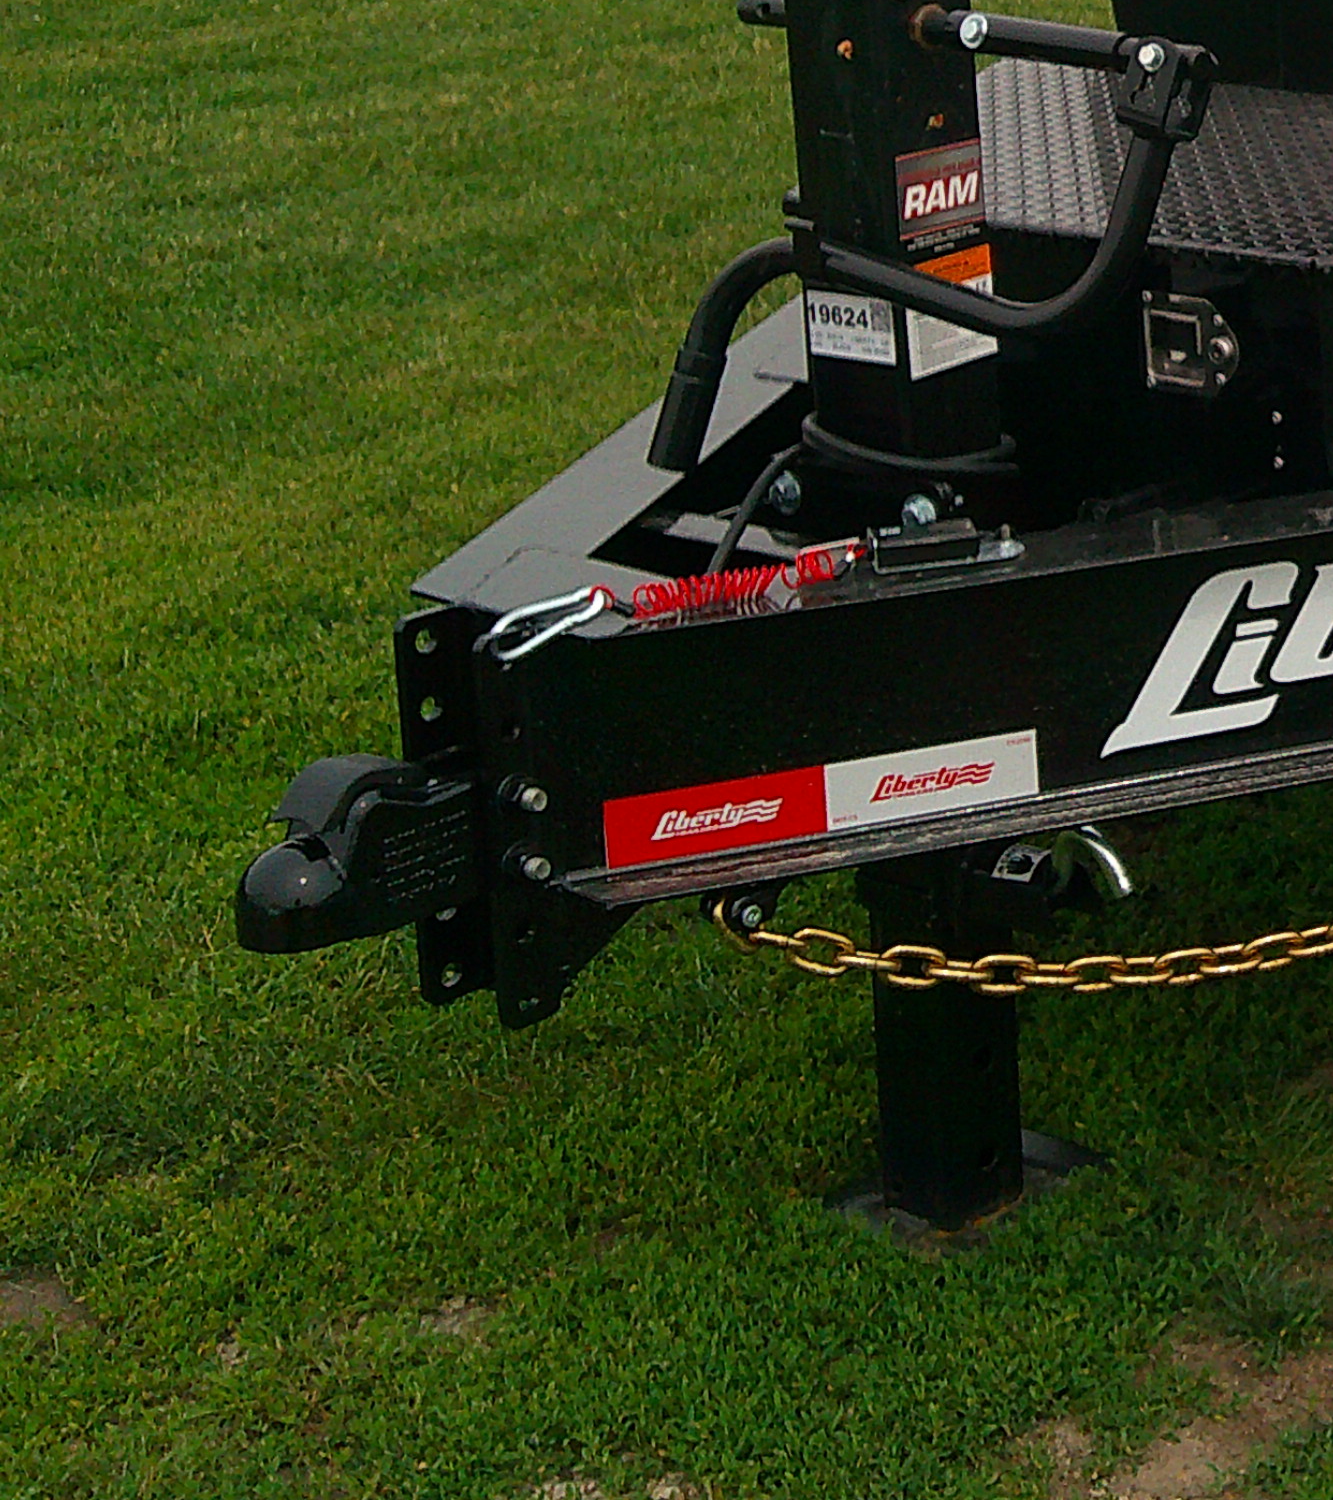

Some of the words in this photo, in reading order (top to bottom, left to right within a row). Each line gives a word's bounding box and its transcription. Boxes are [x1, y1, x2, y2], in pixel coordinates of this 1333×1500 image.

[904, 170, 979, 220] RAM
[808, 302, 868, 329] 19624
[870, 766, 959, 803] Liberty
[651, 802, 746, 841] Liberty
